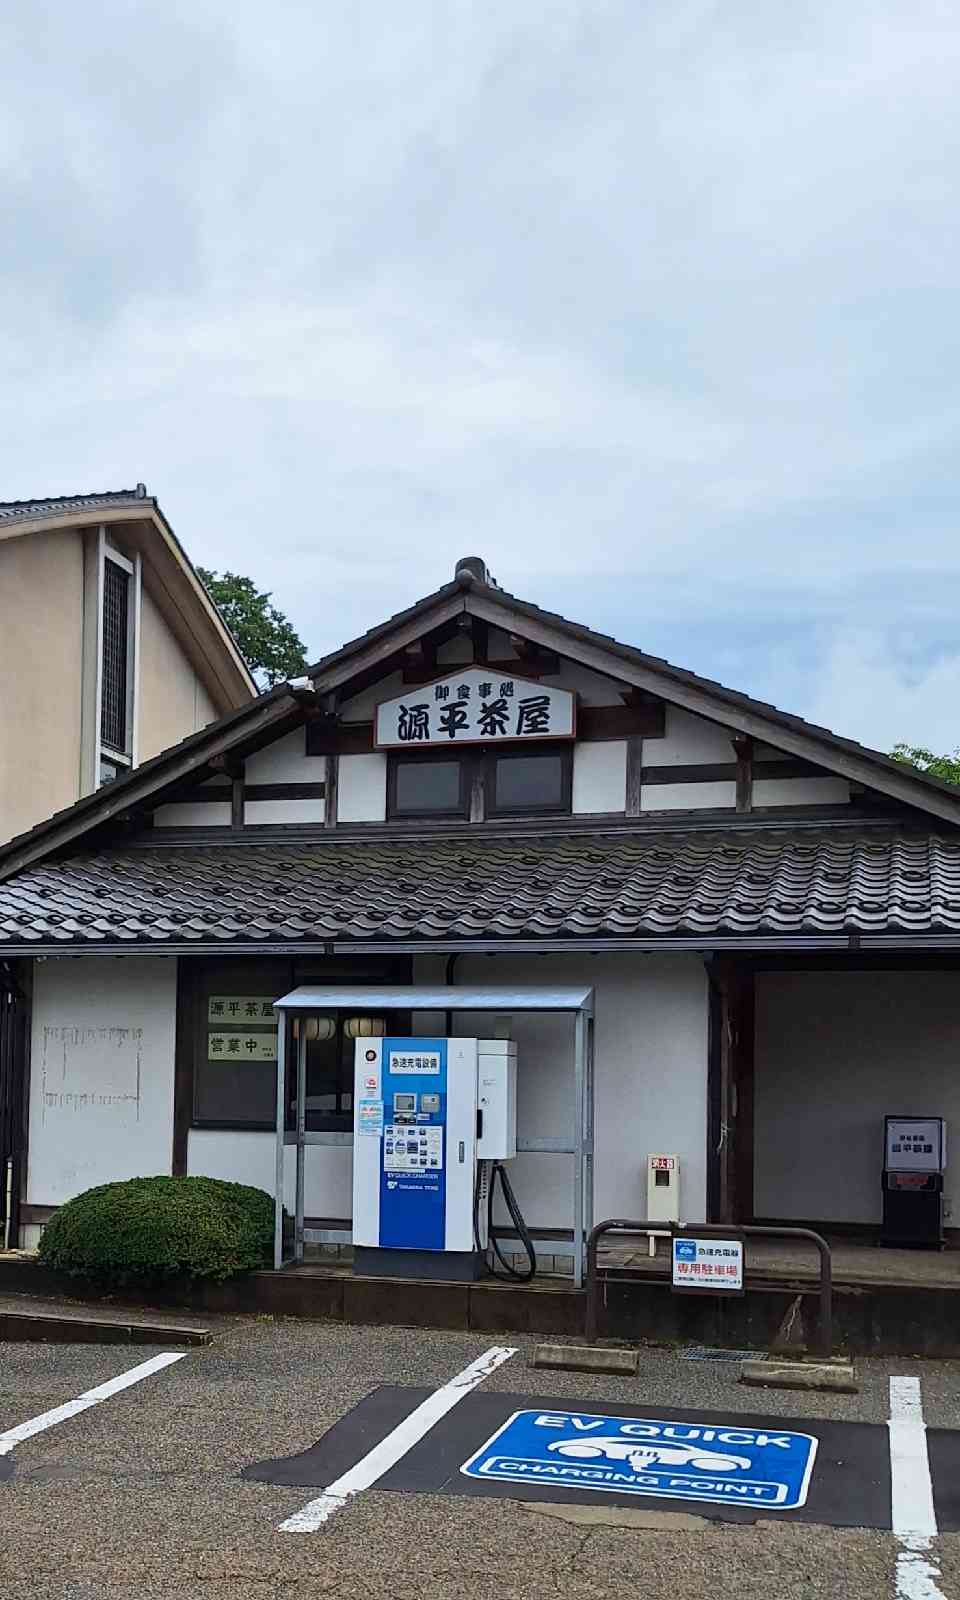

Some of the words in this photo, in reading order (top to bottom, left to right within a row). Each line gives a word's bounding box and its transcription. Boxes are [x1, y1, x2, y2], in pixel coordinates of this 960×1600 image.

[398, 696, 551, 741] 源平茶屋
[210, 1001, 275, 1017] 源平茶屋
[211, 1038, 257, 1053] 営業中
[392, 1056, 437, 1069] 急速充電設備
[677, 1263, 737, 1277] 専用駐車場
[533, 1414, 605, 1432] EV
[618, 1423, 792, 1449] QUICK
[498, 1461, 659, 1486] CHARGING
[669, 1479, 772, 1496] POINT
